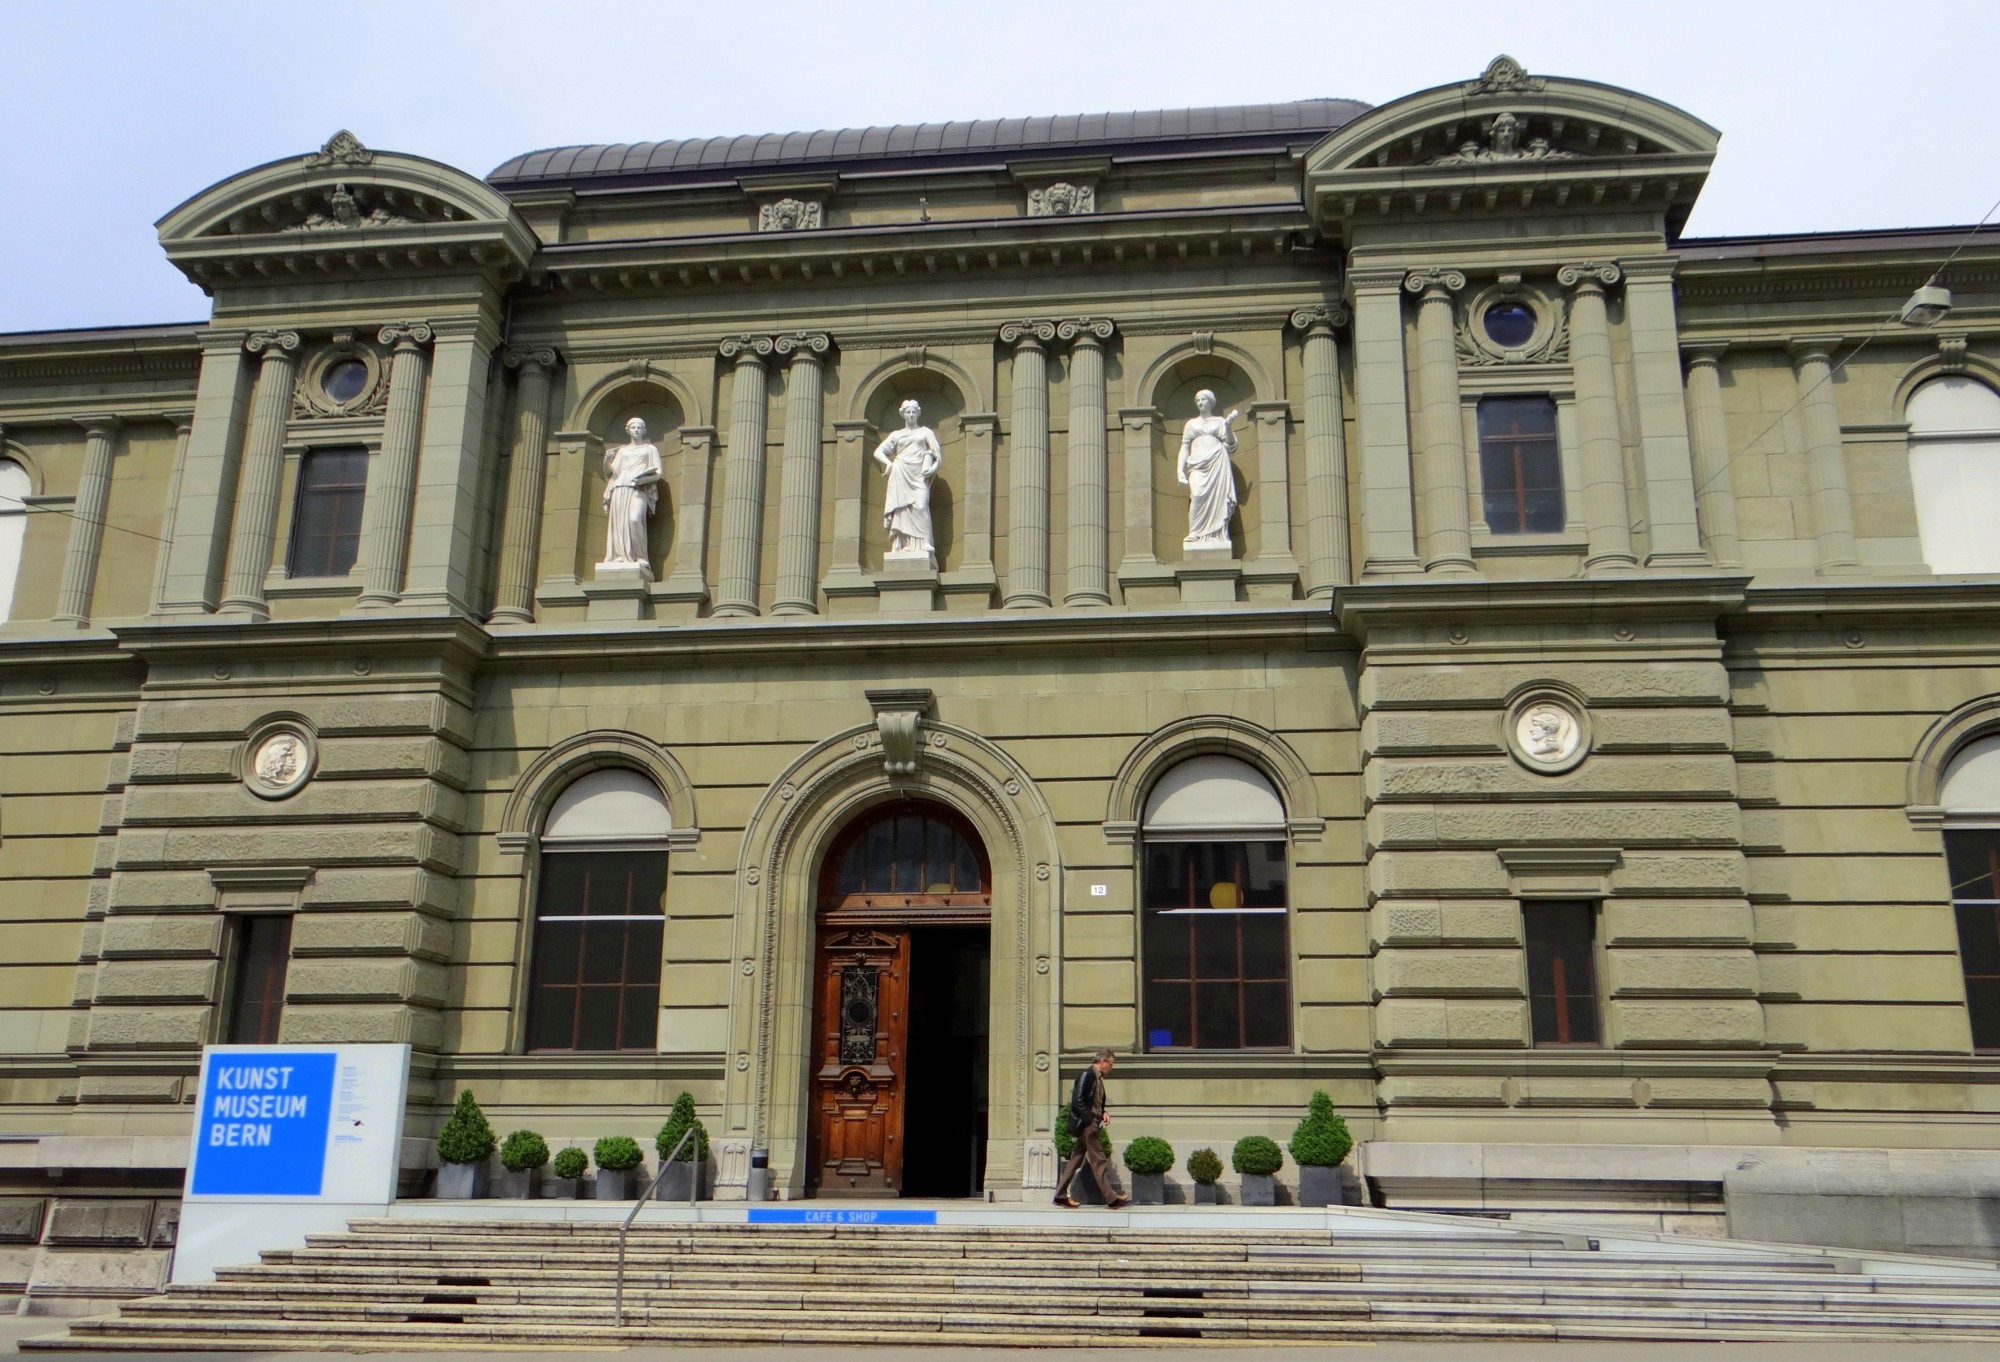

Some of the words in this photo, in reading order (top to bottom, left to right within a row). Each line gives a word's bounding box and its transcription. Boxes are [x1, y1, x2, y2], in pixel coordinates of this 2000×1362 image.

[1094, 886, 1104, 894] 12
[217, 1067, 293, 1089] KUNST
[213, 1095, 306, 1118] MUSEUM
[210, 1123, 272, 1146] BERN
[805, 1211, 833, 1222] CAFE
[836, 1211, 844, 1222] &
[848, 1211, 878, 1222] SHOP
